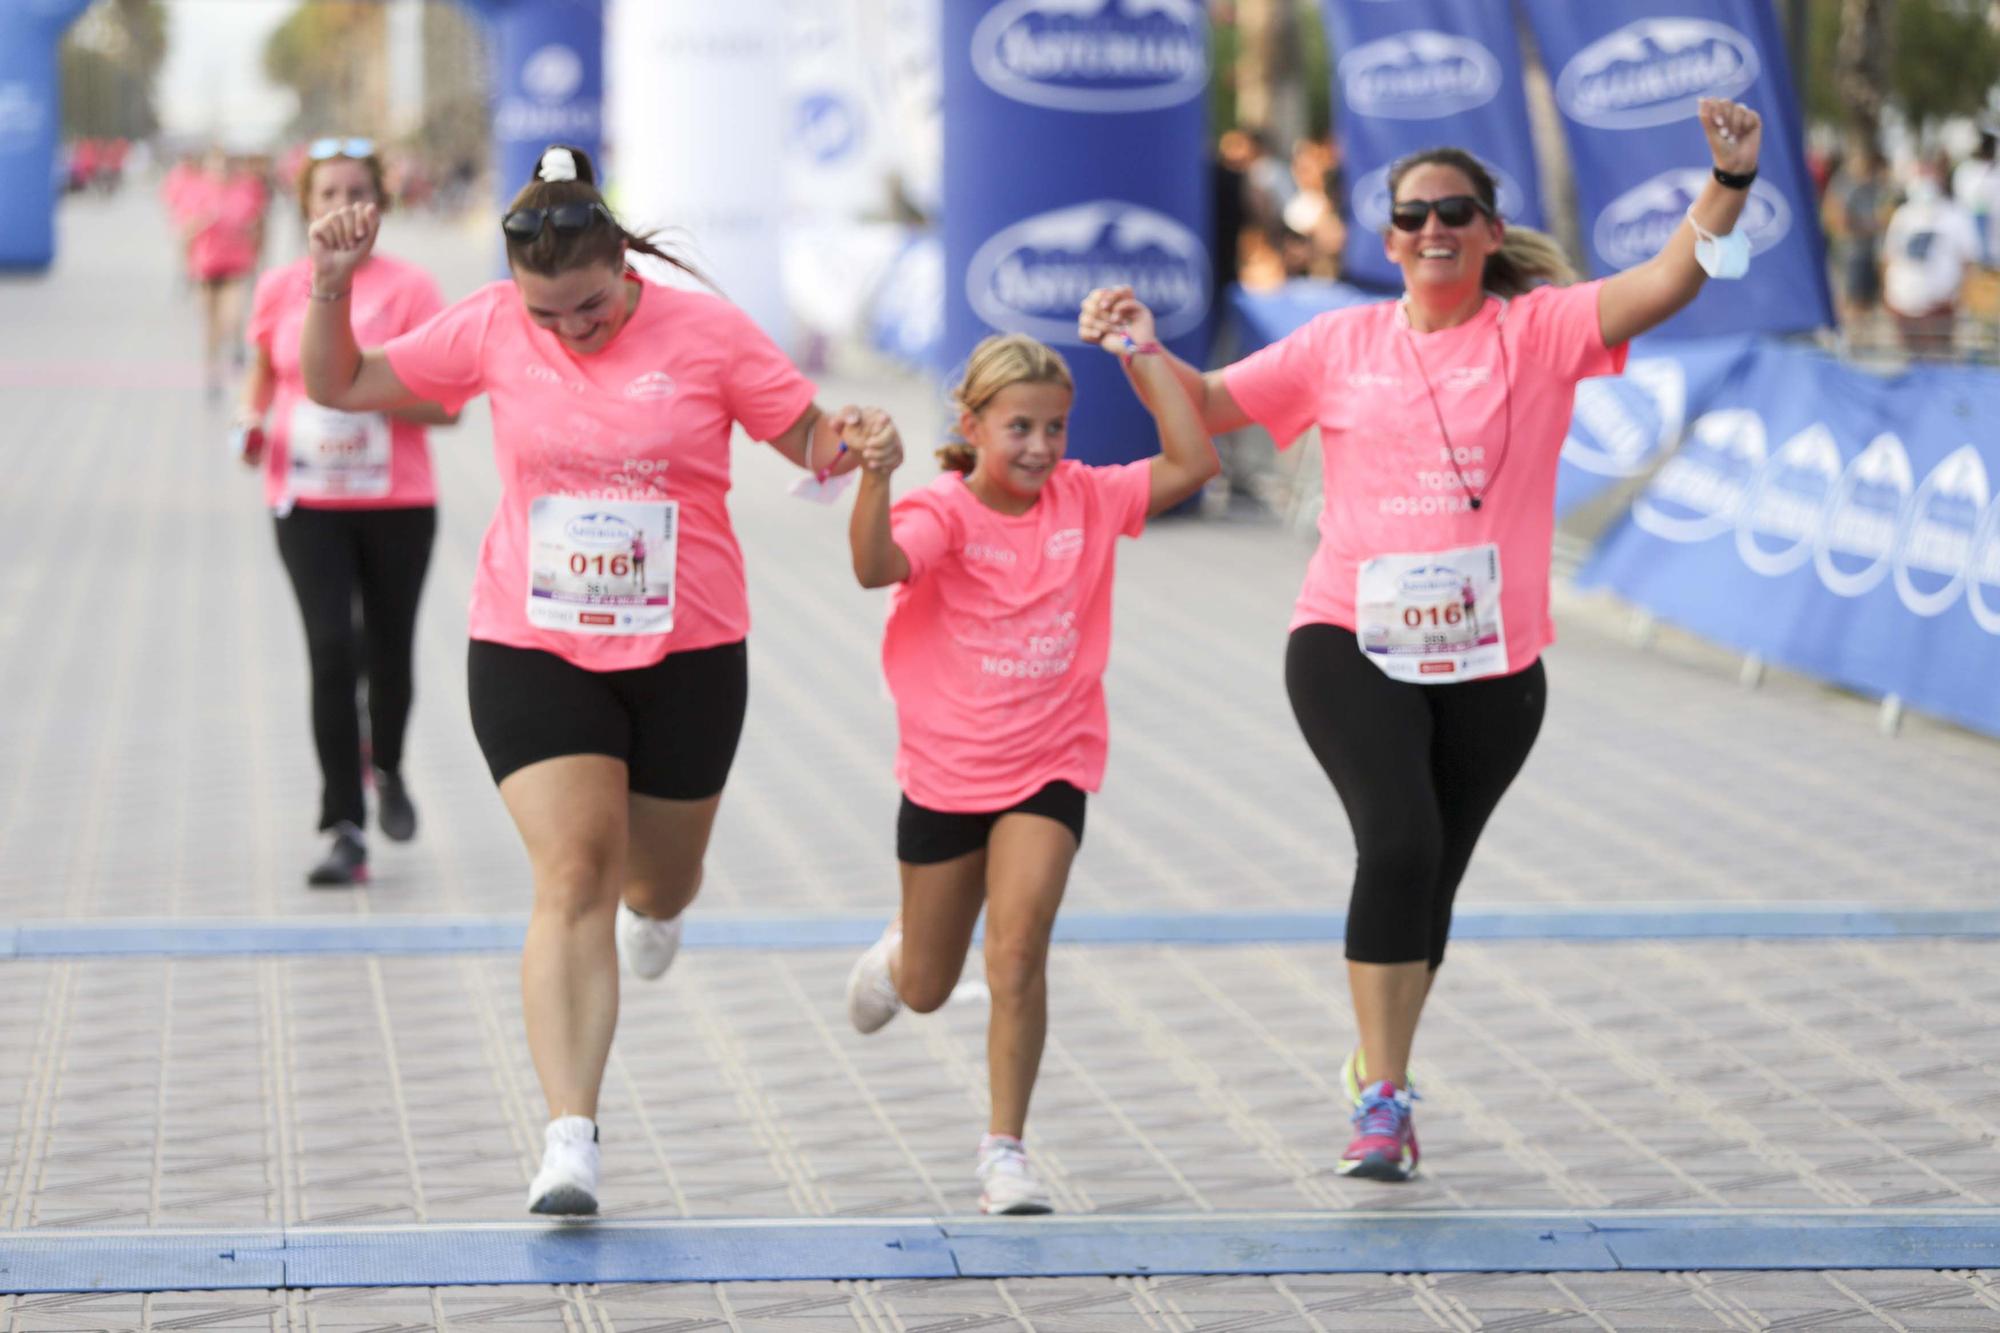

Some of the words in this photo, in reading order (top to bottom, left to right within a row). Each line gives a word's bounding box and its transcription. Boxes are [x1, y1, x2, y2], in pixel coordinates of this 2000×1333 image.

[1440, 446, 1485, 464] POR
[1379, 496, 1478, 515] NOSOTRA
[569, 553, 629, 577] 016
[1403, 602, 1462, 627] 016
